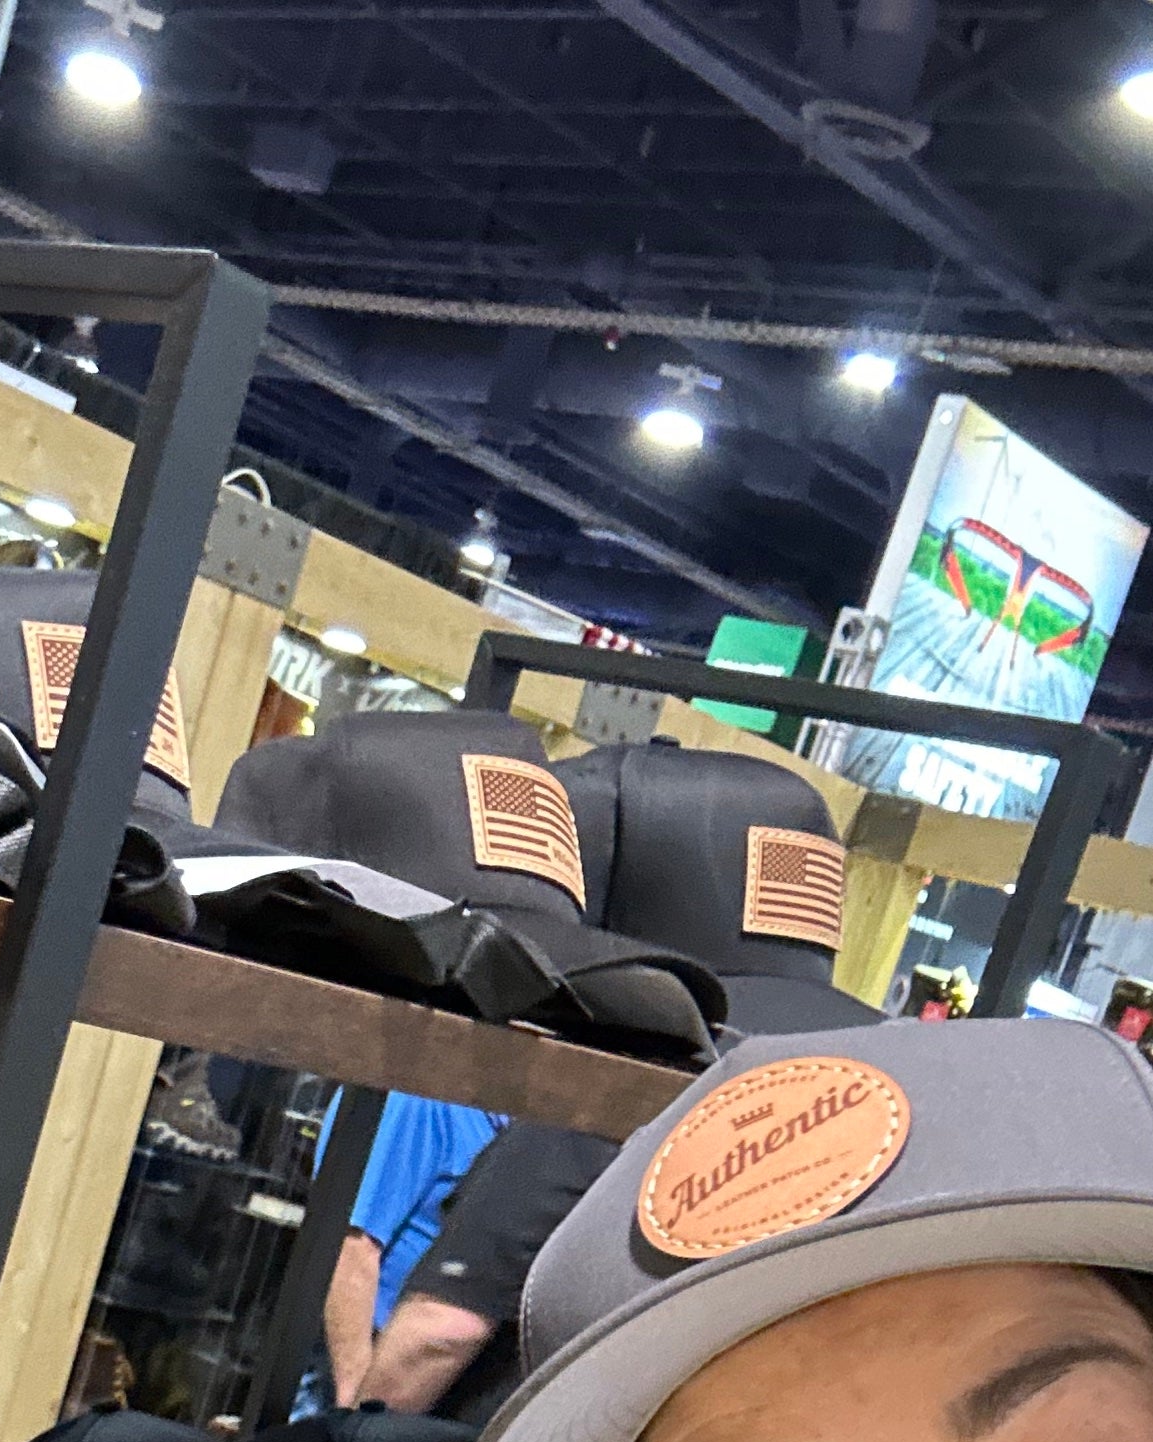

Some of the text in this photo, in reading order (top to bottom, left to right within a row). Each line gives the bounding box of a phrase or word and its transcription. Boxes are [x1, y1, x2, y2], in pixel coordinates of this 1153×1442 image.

[667, 1081, 871, 1229] Authentic
[716, 1181, 768, 1211] LEATHER
[771, 1164, 811, 1185] PATCH
